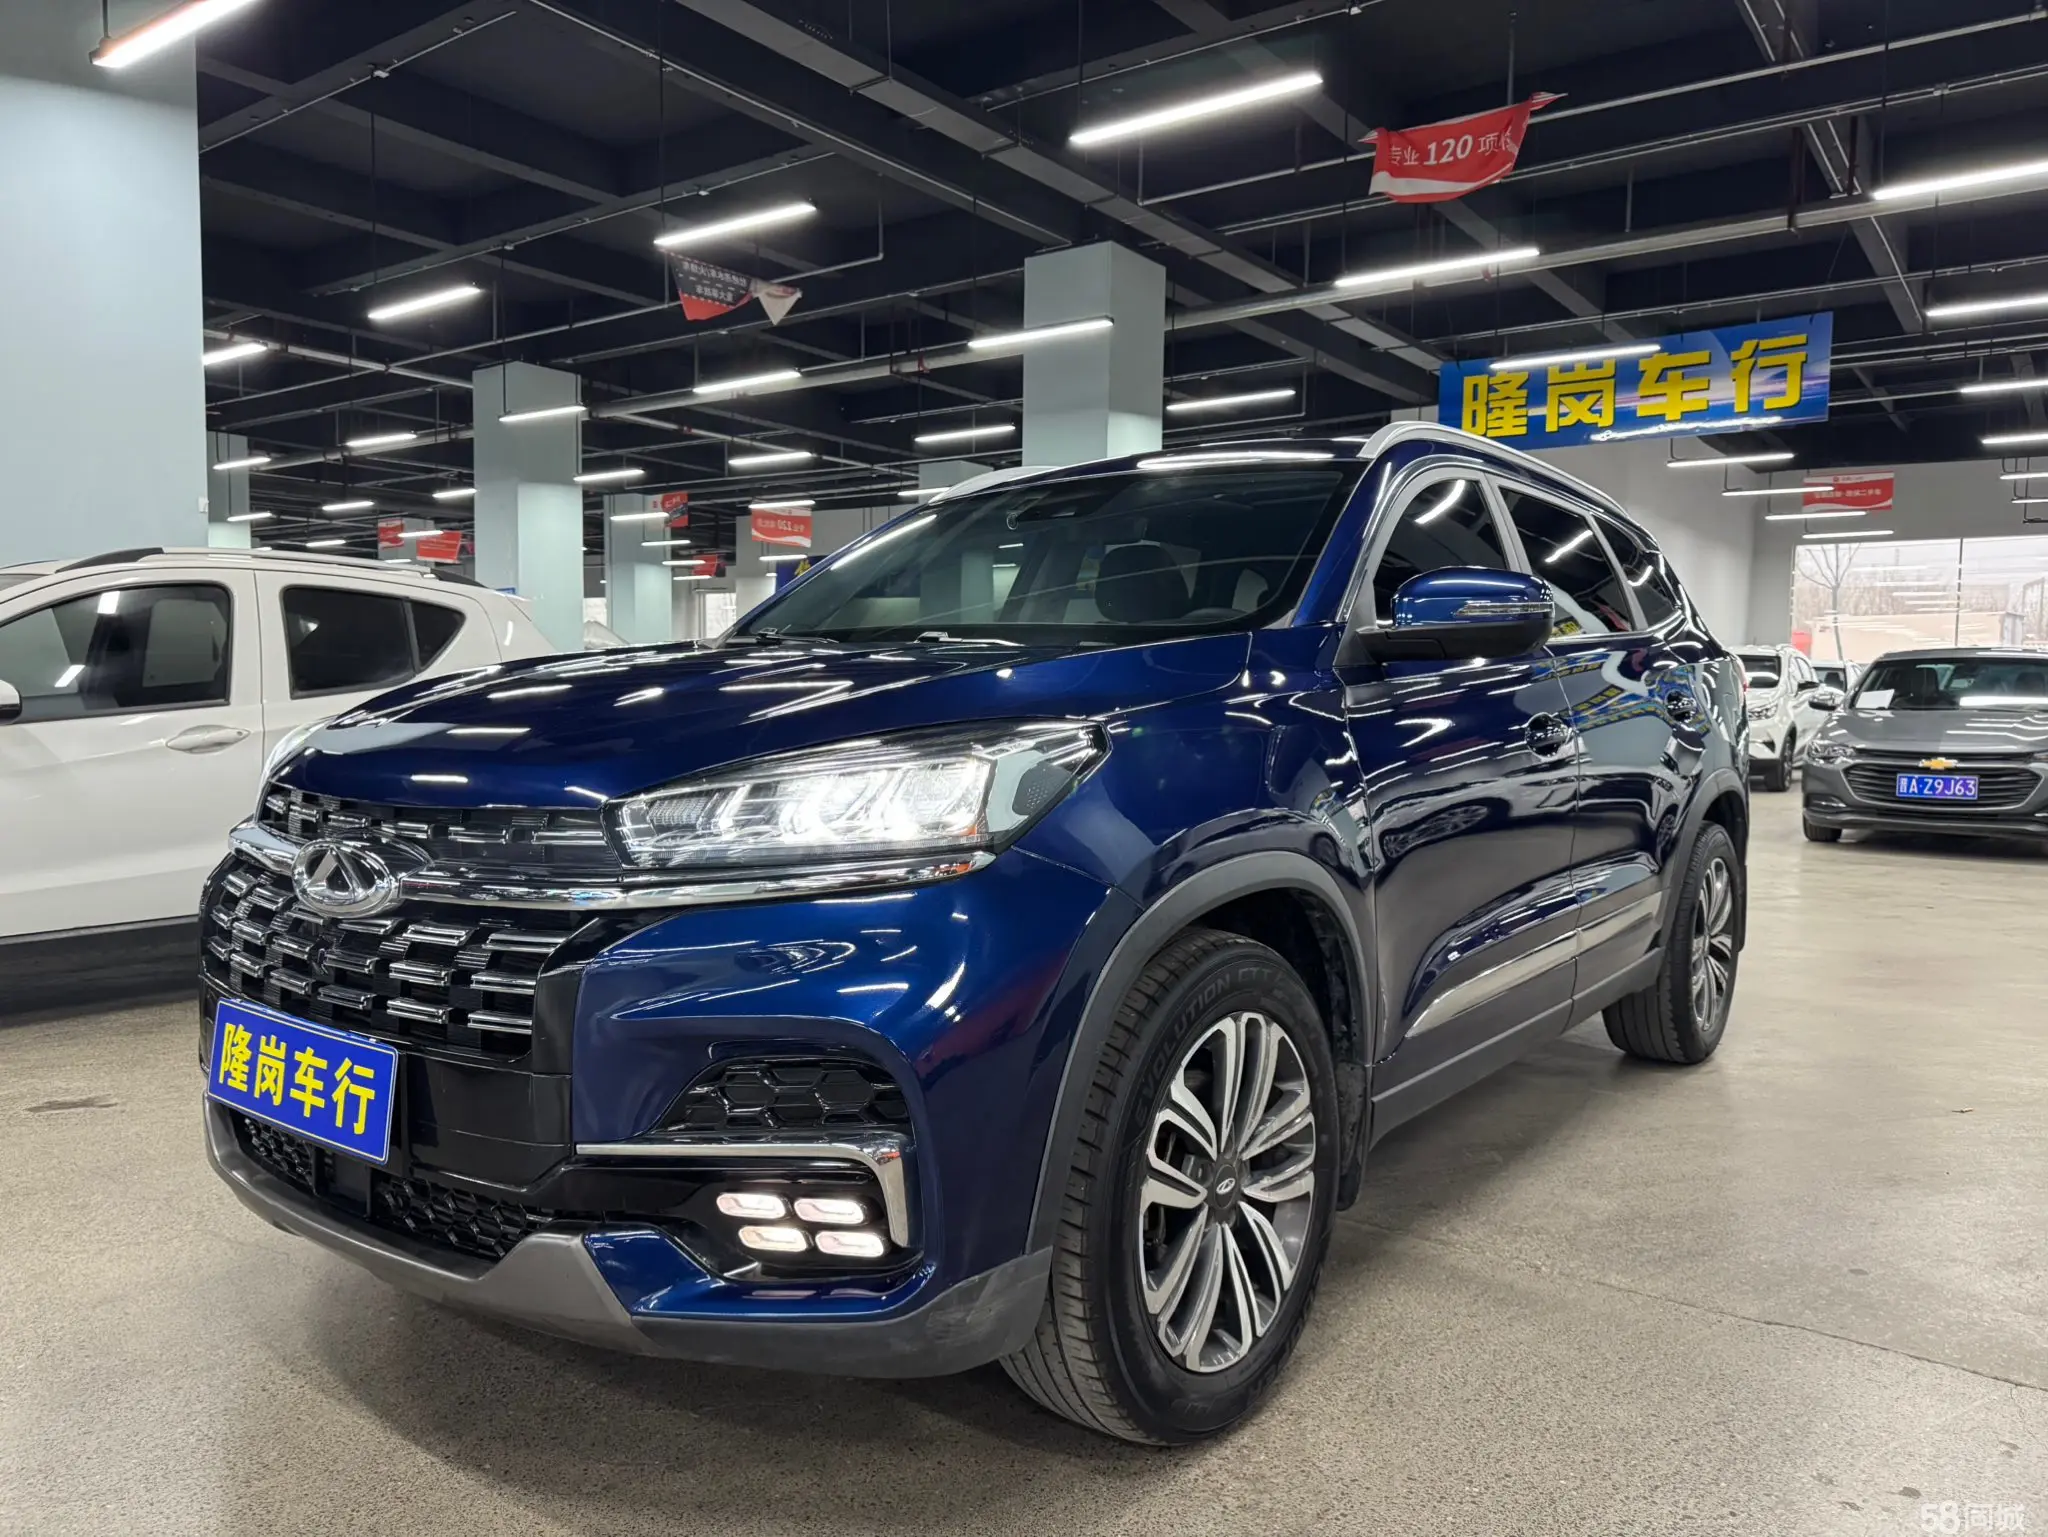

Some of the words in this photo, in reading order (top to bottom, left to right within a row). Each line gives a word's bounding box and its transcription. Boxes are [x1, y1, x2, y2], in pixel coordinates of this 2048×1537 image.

[1423, 134, 1474, 166] 120
[1461, 334, 1809, 438] 隆岗车行
[218, 1022, 376, 1135] 隆岗车行
[1135, 972, 1231, 1128] EVOLUTION
